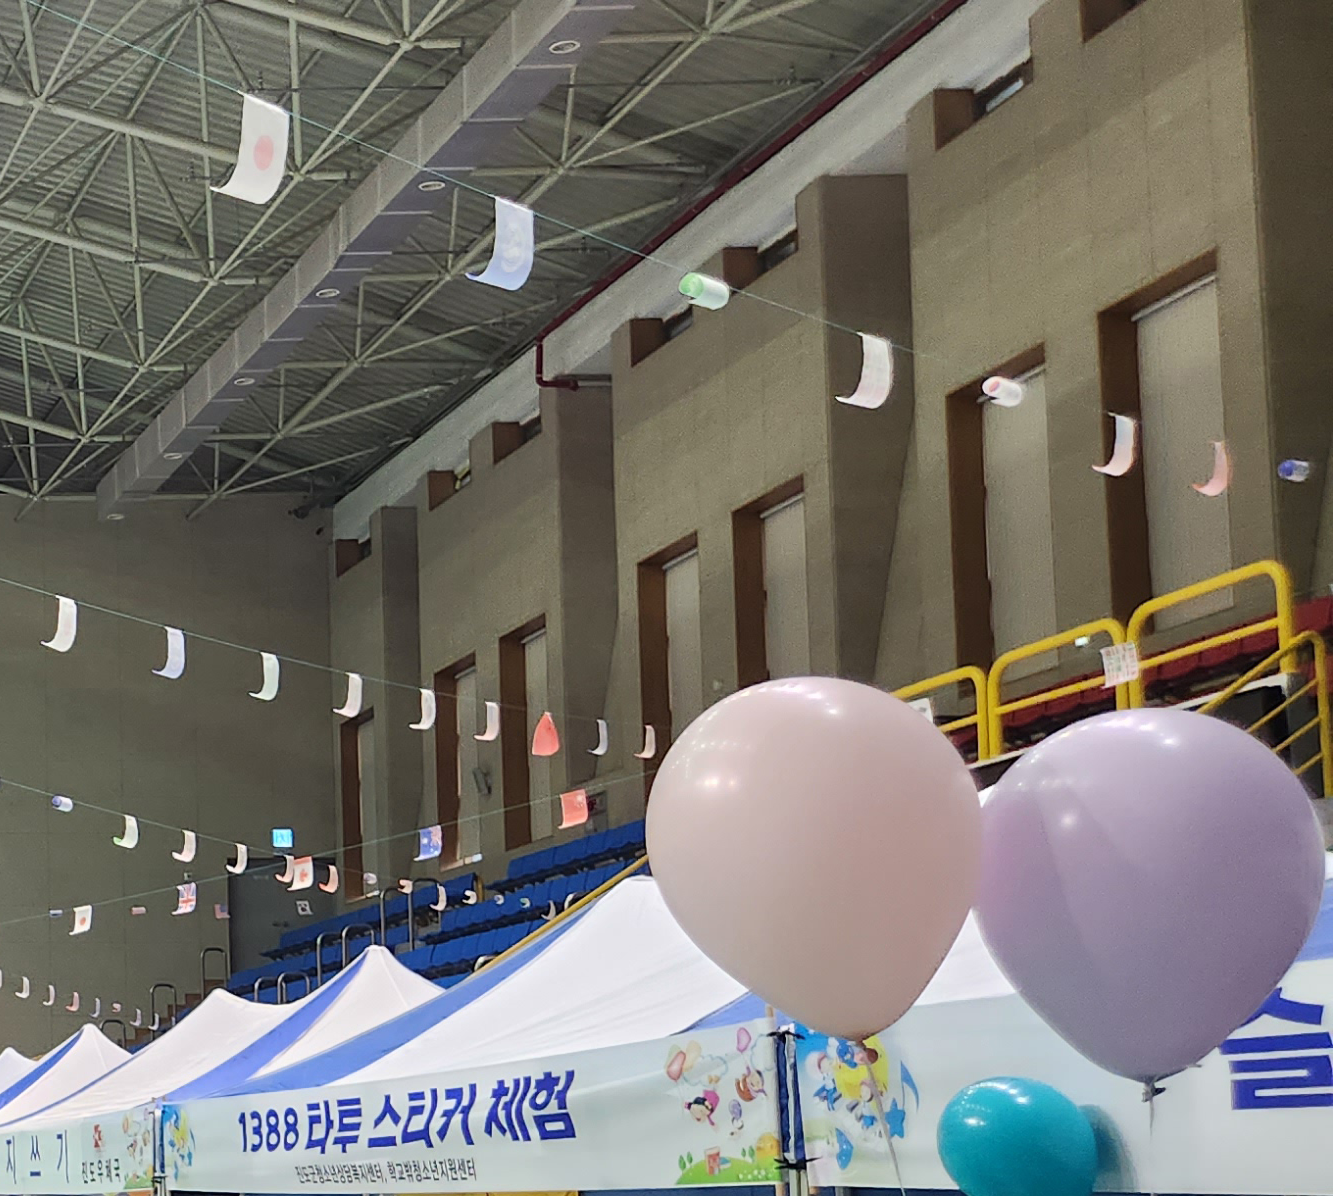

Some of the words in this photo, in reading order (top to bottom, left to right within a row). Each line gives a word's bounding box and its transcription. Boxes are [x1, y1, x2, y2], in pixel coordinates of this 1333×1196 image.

[238, 1107, 300, 1154] 1388
[304, 1096, 364, 1155] 타투
[367, 1082, 478, 1150] 스티커
[483, 1069, 577, 1143] 체험
